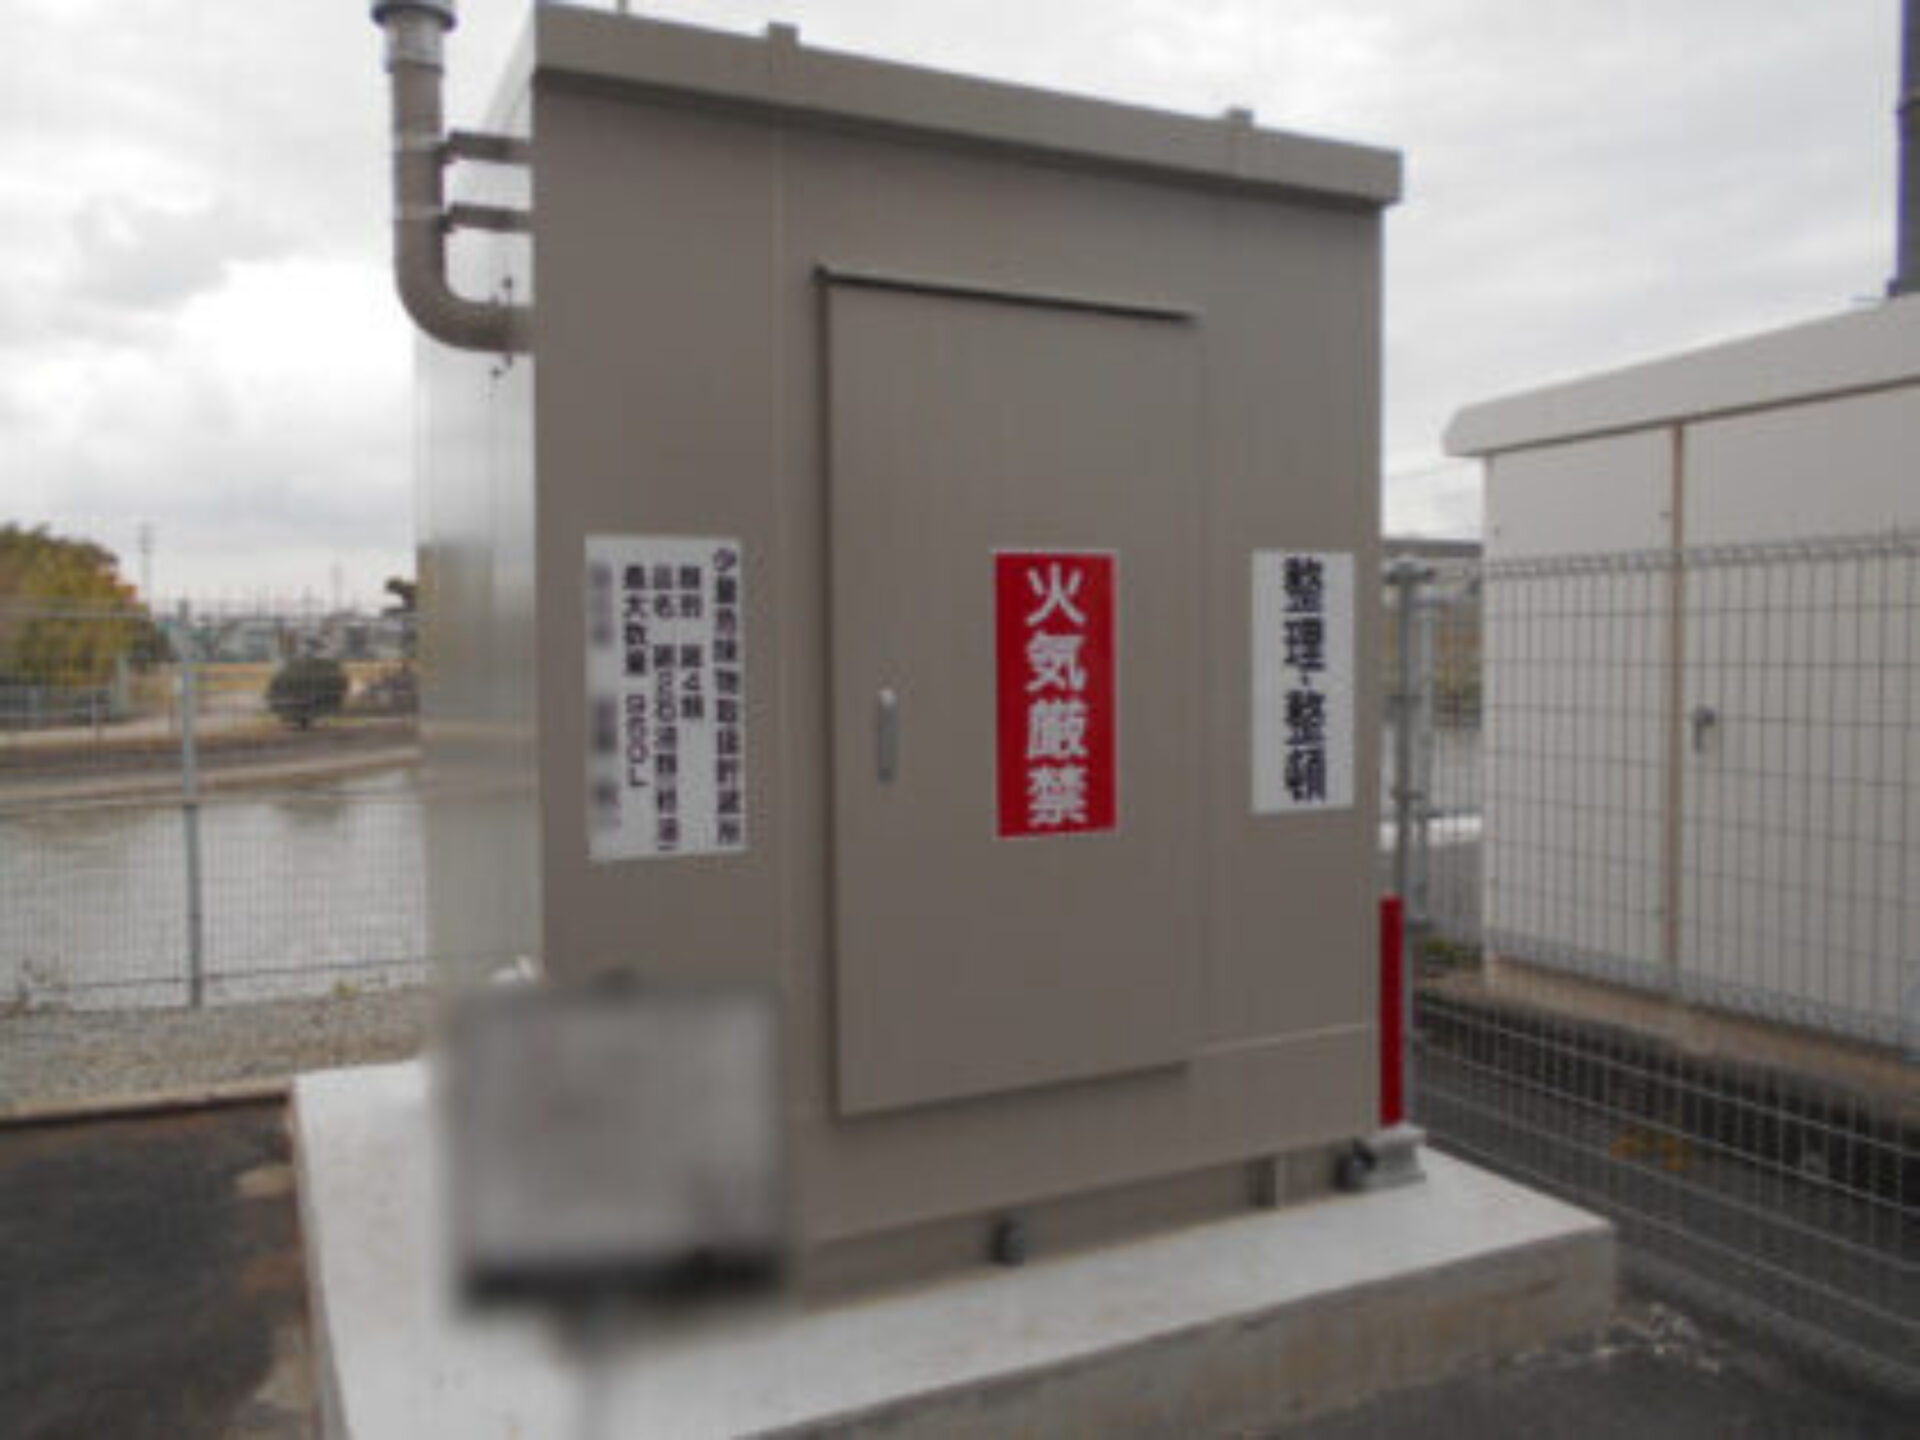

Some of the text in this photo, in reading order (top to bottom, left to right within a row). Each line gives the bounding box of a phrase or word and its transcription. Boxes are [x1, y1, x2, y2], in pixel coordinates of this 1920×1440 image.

[623, 565, 647, 676] 最大数量
[652, 564, 675, 618] 品名
[1025, 562, 1087, 827] 火気厳禁
